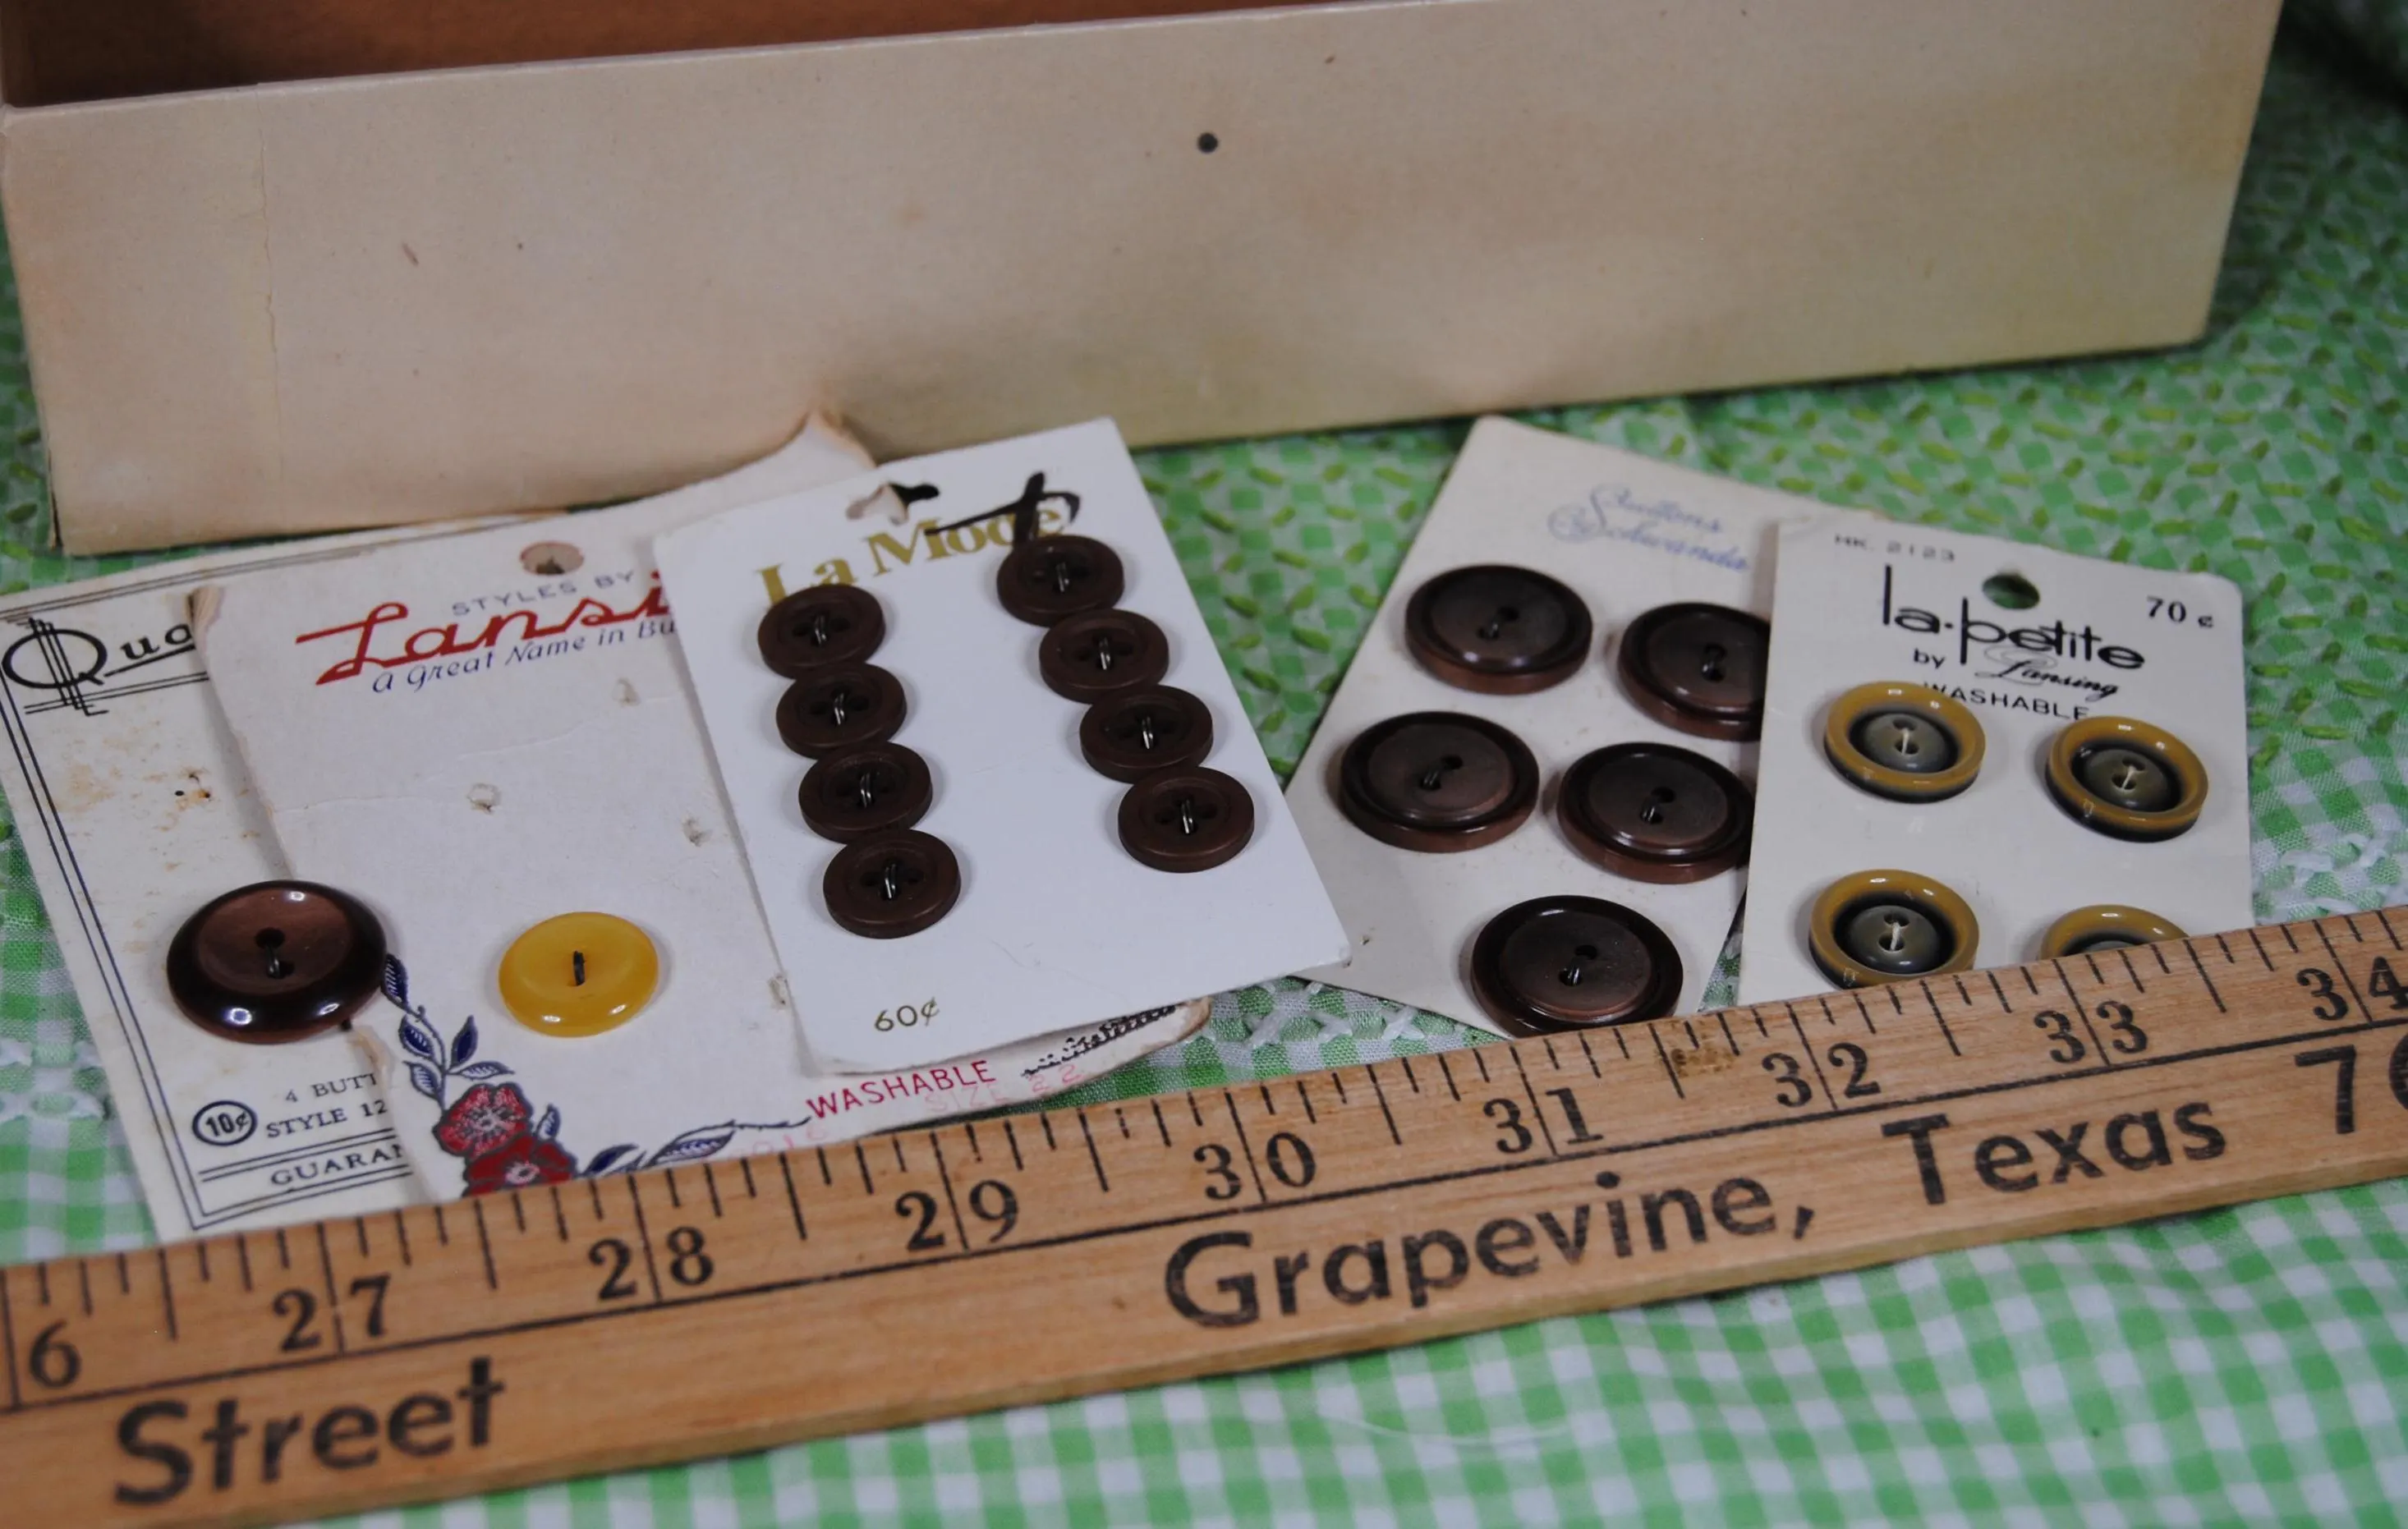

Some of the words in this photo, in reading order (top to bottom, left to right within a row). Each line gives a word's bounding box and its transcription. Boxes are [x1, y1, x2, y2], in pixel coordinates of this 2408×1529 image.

[453, 580, 577, 616] STYLES
[594, 571, 634, 590] BY
[407, 650, 493, 693] Great
[504, 636, 586, 666] Name
[598, 627, 624, 646] in
[1914, 649, 1945, 668] by
[1974, 645, 2119, 702] Lansing
[875, 997, 941, 1032] 60¢
[285, 1089, 300, 1103] 4
[806, 1059, 997, 1119] WASHABLE
[205, 1111, 249, 1138] 10¢
[266, 1108, 348, 1139] STYLE
[113, 1357, 506, 1506] Street
[1165, 1172, 1815, 1329] Grapevine,
[1882, 1101, 2226, 1206] Texas
